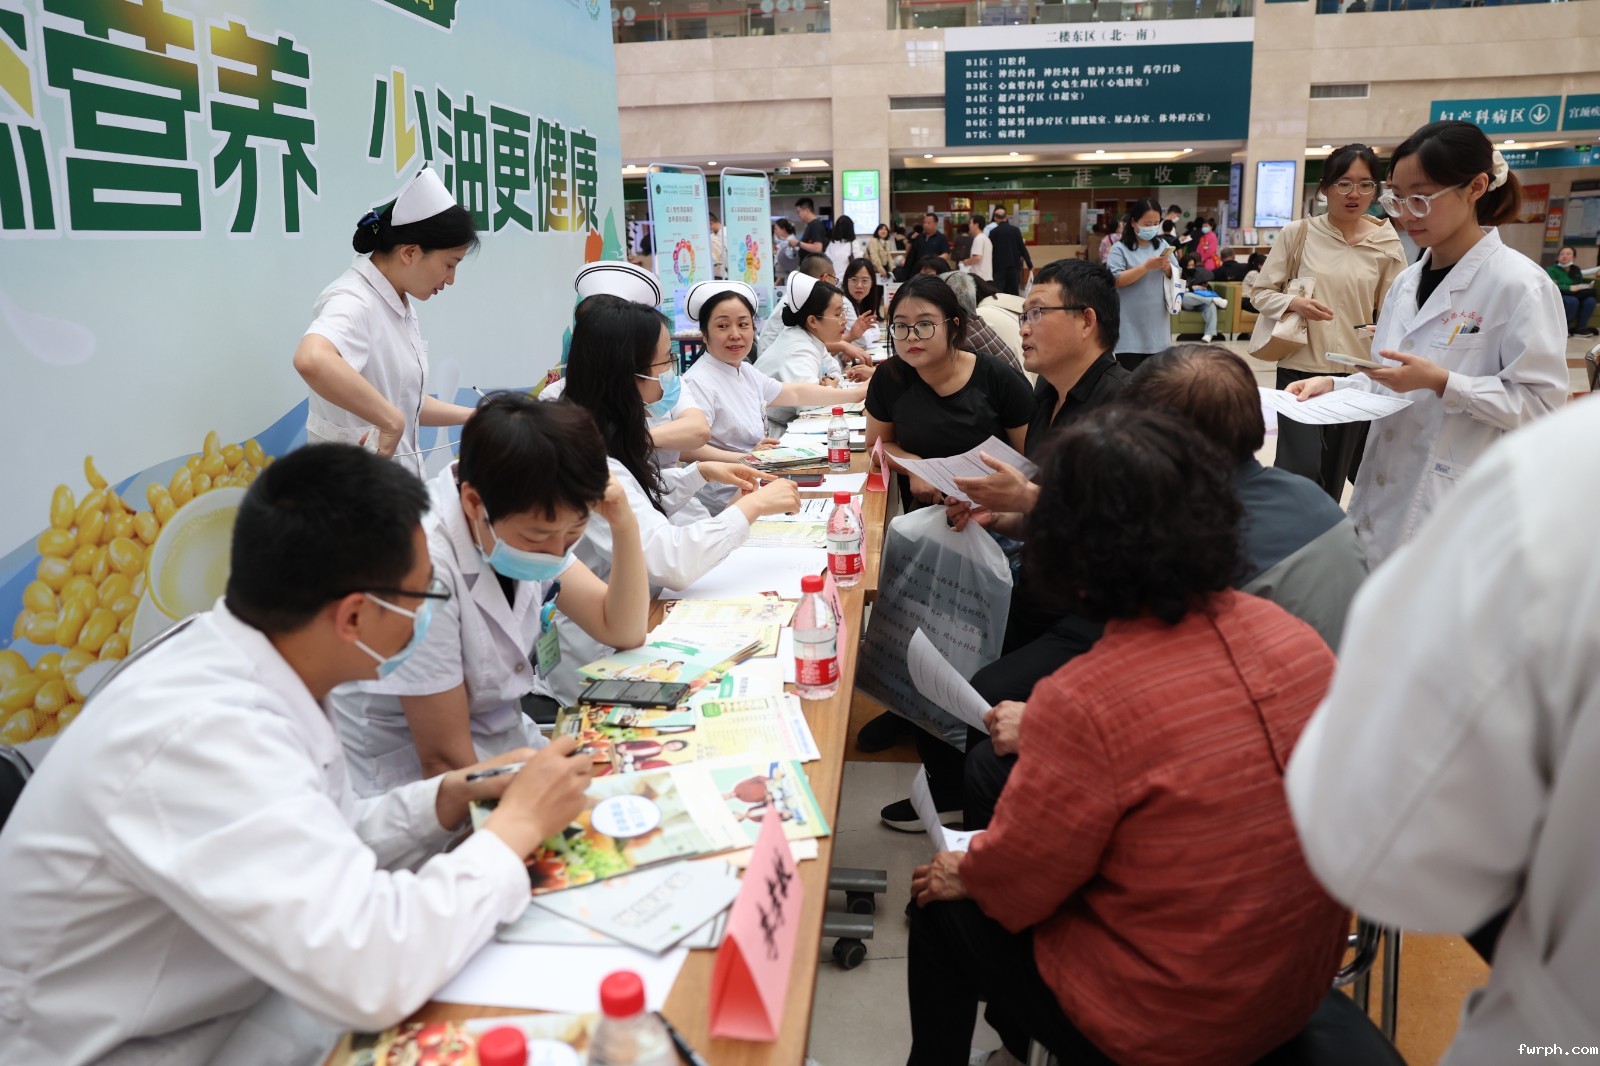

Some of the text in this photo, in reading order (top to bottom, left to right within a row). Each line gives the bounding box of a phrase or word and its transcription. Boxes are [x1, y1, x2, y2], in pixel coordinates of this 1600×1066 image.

[368, 69, 599, 232] 少油更健康
